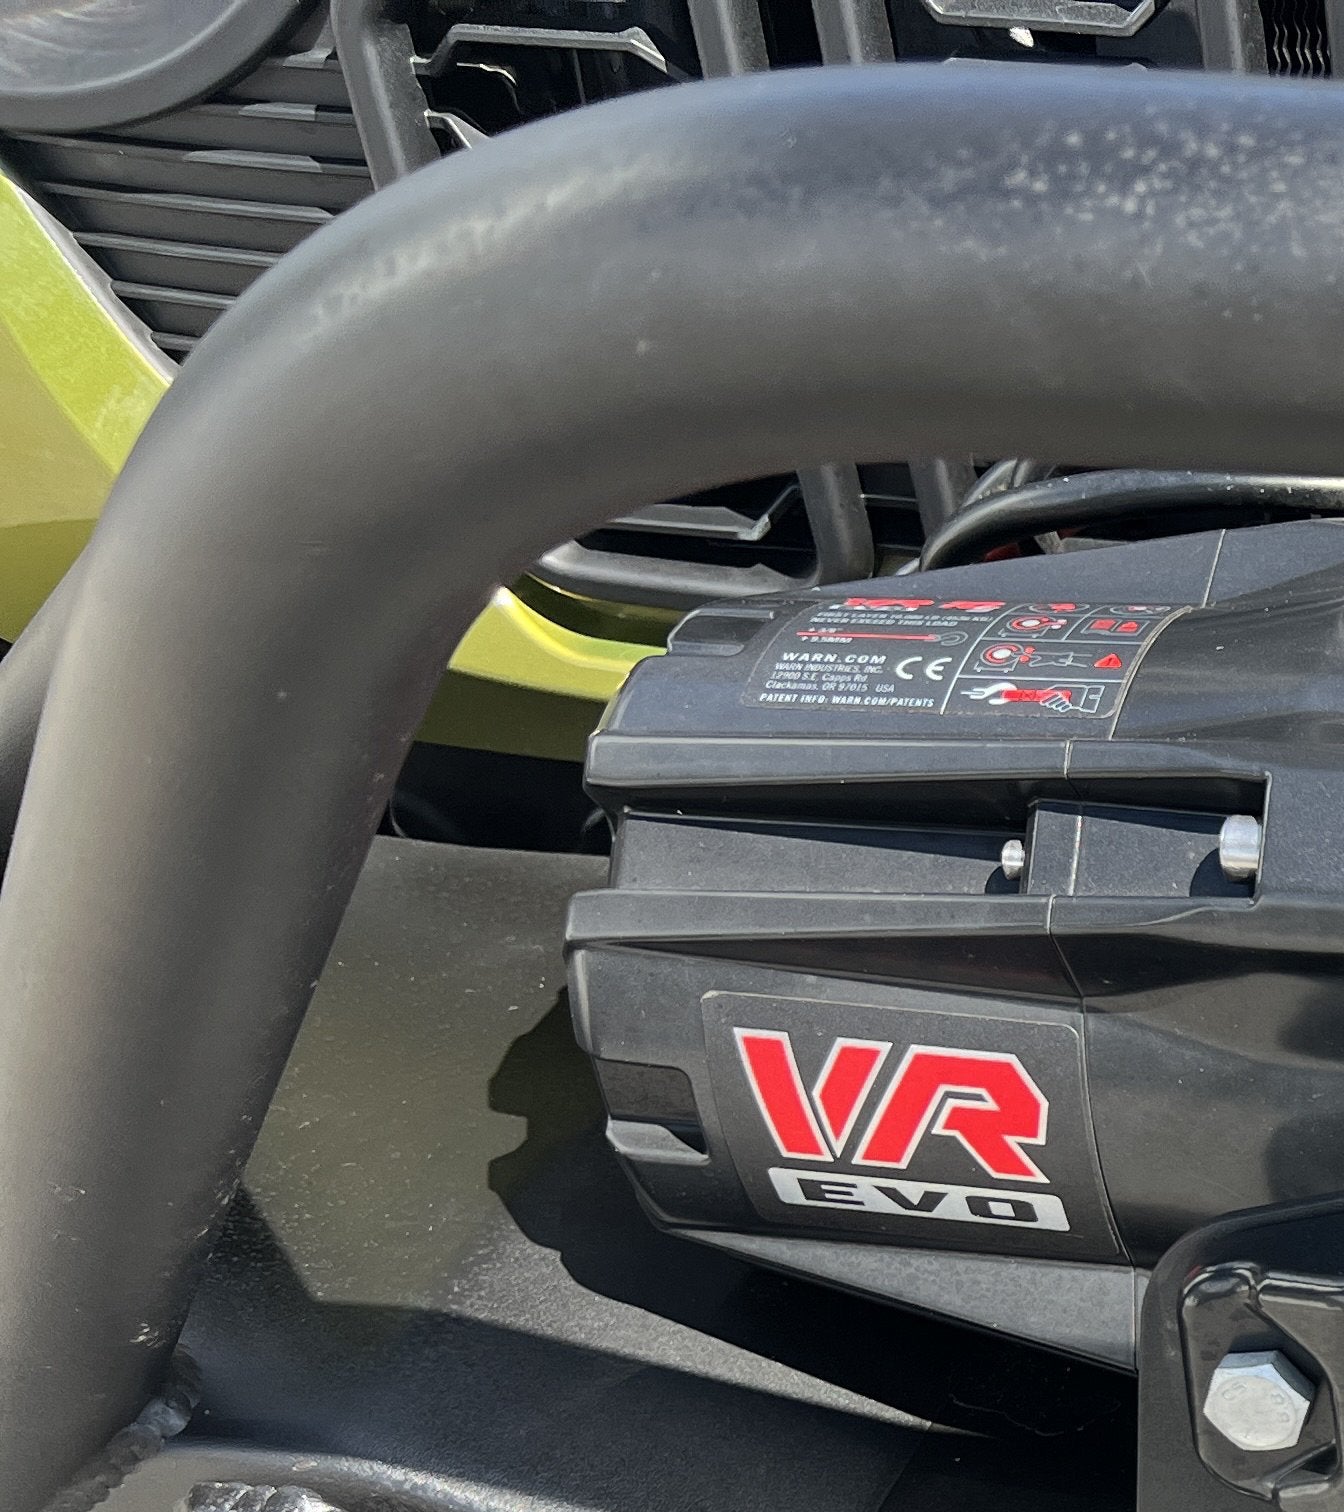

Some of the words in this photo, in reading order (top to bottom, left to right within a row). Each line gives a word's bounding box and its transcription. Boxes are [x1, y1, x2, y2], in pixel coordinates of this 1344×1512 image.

[783, 652, 887, 665] WARN.COM
[775, 663, 802, 671] WARN
[822, 673, 851, 684] Capps
[853, 674, 868, 682] Rd
[822, 682, 837, 691] OR
[875, 683, 895, 693] USA
[759, 693, 798, 703] PATENT
[832, 695, 935, 708] WARN.COM/PATENTS
[733, 1026, 1051, 1184] VR
[796, 1177, 1040, 1223] EVO
